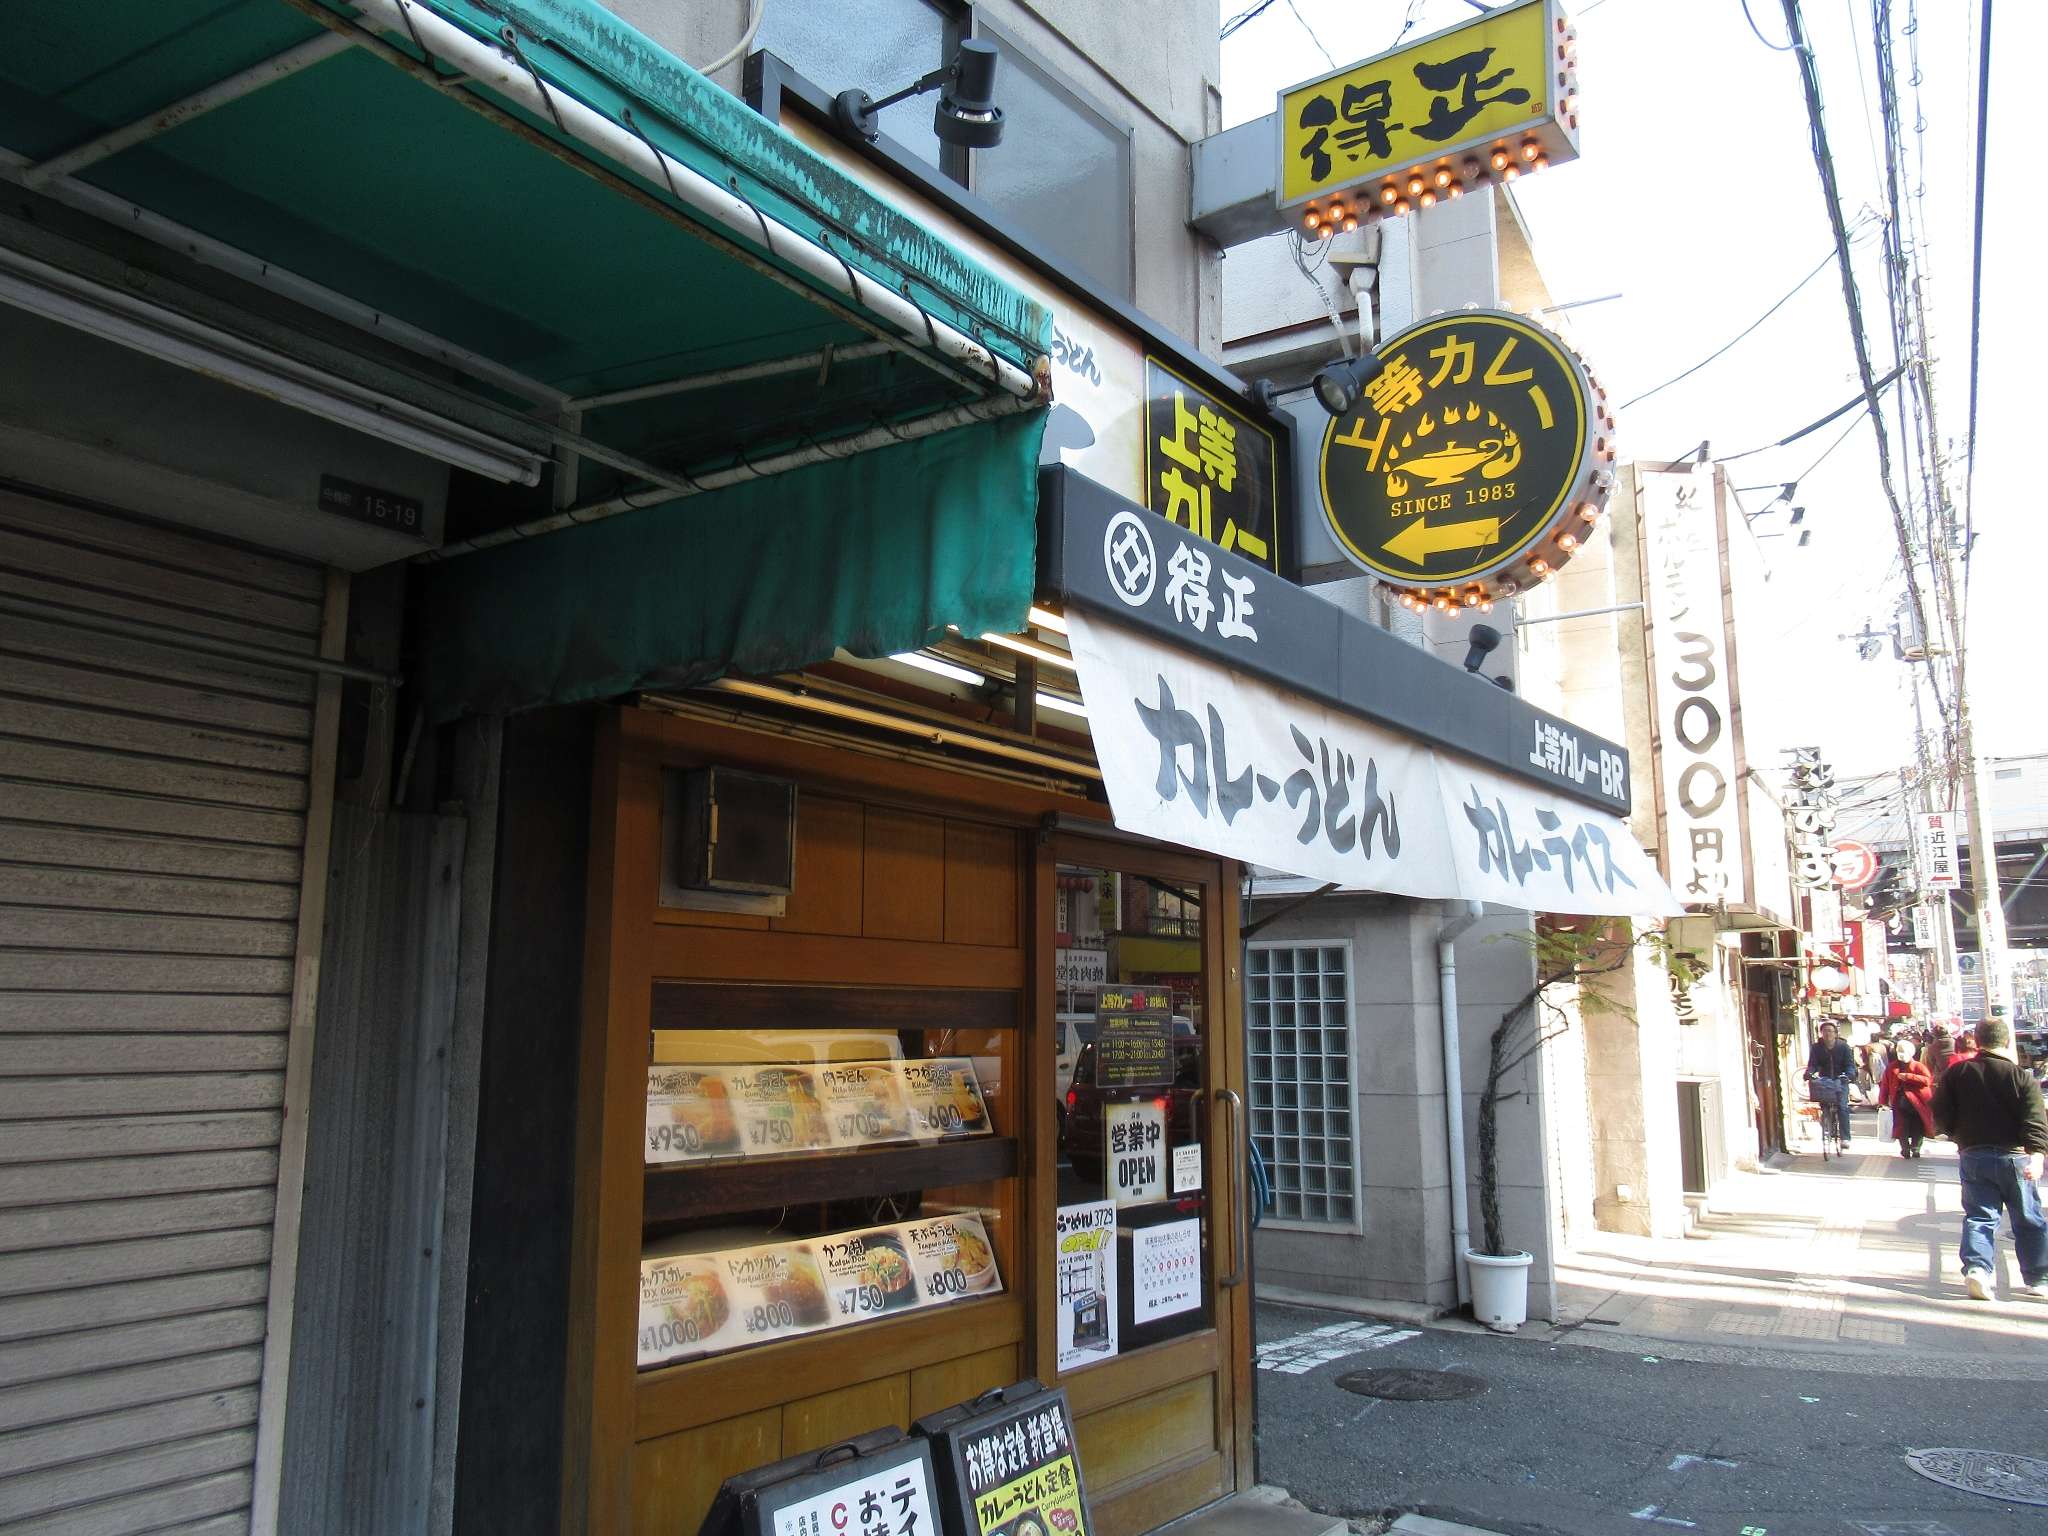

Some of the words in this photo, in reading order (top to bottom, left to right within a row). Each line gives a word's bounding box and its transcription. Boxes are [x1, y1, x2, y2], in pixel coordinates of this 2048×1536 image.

[1300, 47, 1531, 182] 得正
[1335, 335, 1554, 472] 上等カレー
[1160, 390, 1238, 493] 上等
[364, 496, 416, 527] 15-19
[1391, 494, 1451, 518] SINCE
[1465, 483, 1516, 505] 1983
[1165, 541, 1259, 643] 得正
[1134, 672, 1401, 861] カレーうどん
[1463, 783, 1637, 894] カレーライス
[1929, 831, 1950, 873] 近江屋
[822, 1069, 868, 1087] 肉うどん
[649, 1123, 700, 1152] ¥950
[750, 1118, 794, 1146] ¥750
[1112, 1120, 1161, 1153] 営業中
[1118, 1155, 1156, 1188] OPEN
[908, 1223, 960, 1244] 天ぷらうどん
[1094, 1208, 1114, 1228] 3729
[728, 1255, 787, 1275] トンカツカレー
[823, 1238, 865, 1259] かつ丼
[829, 1257, 851, 1268] Katsu
[852, 1254, 867, 1264] Don
[928, 1268, 967, 1297] ¥800
[841, 1284, 884, 1315] ¥750
[746, 1302, 793, 1333] ¥800
[640, 1319, 699, 1353] ¥1,000
[966, 1421, 1029, 1490] お得な定食
[1027, 1405, 1068, 1462] 新登場
[981, 1463, 1071, 1527] カレーうどん定食
